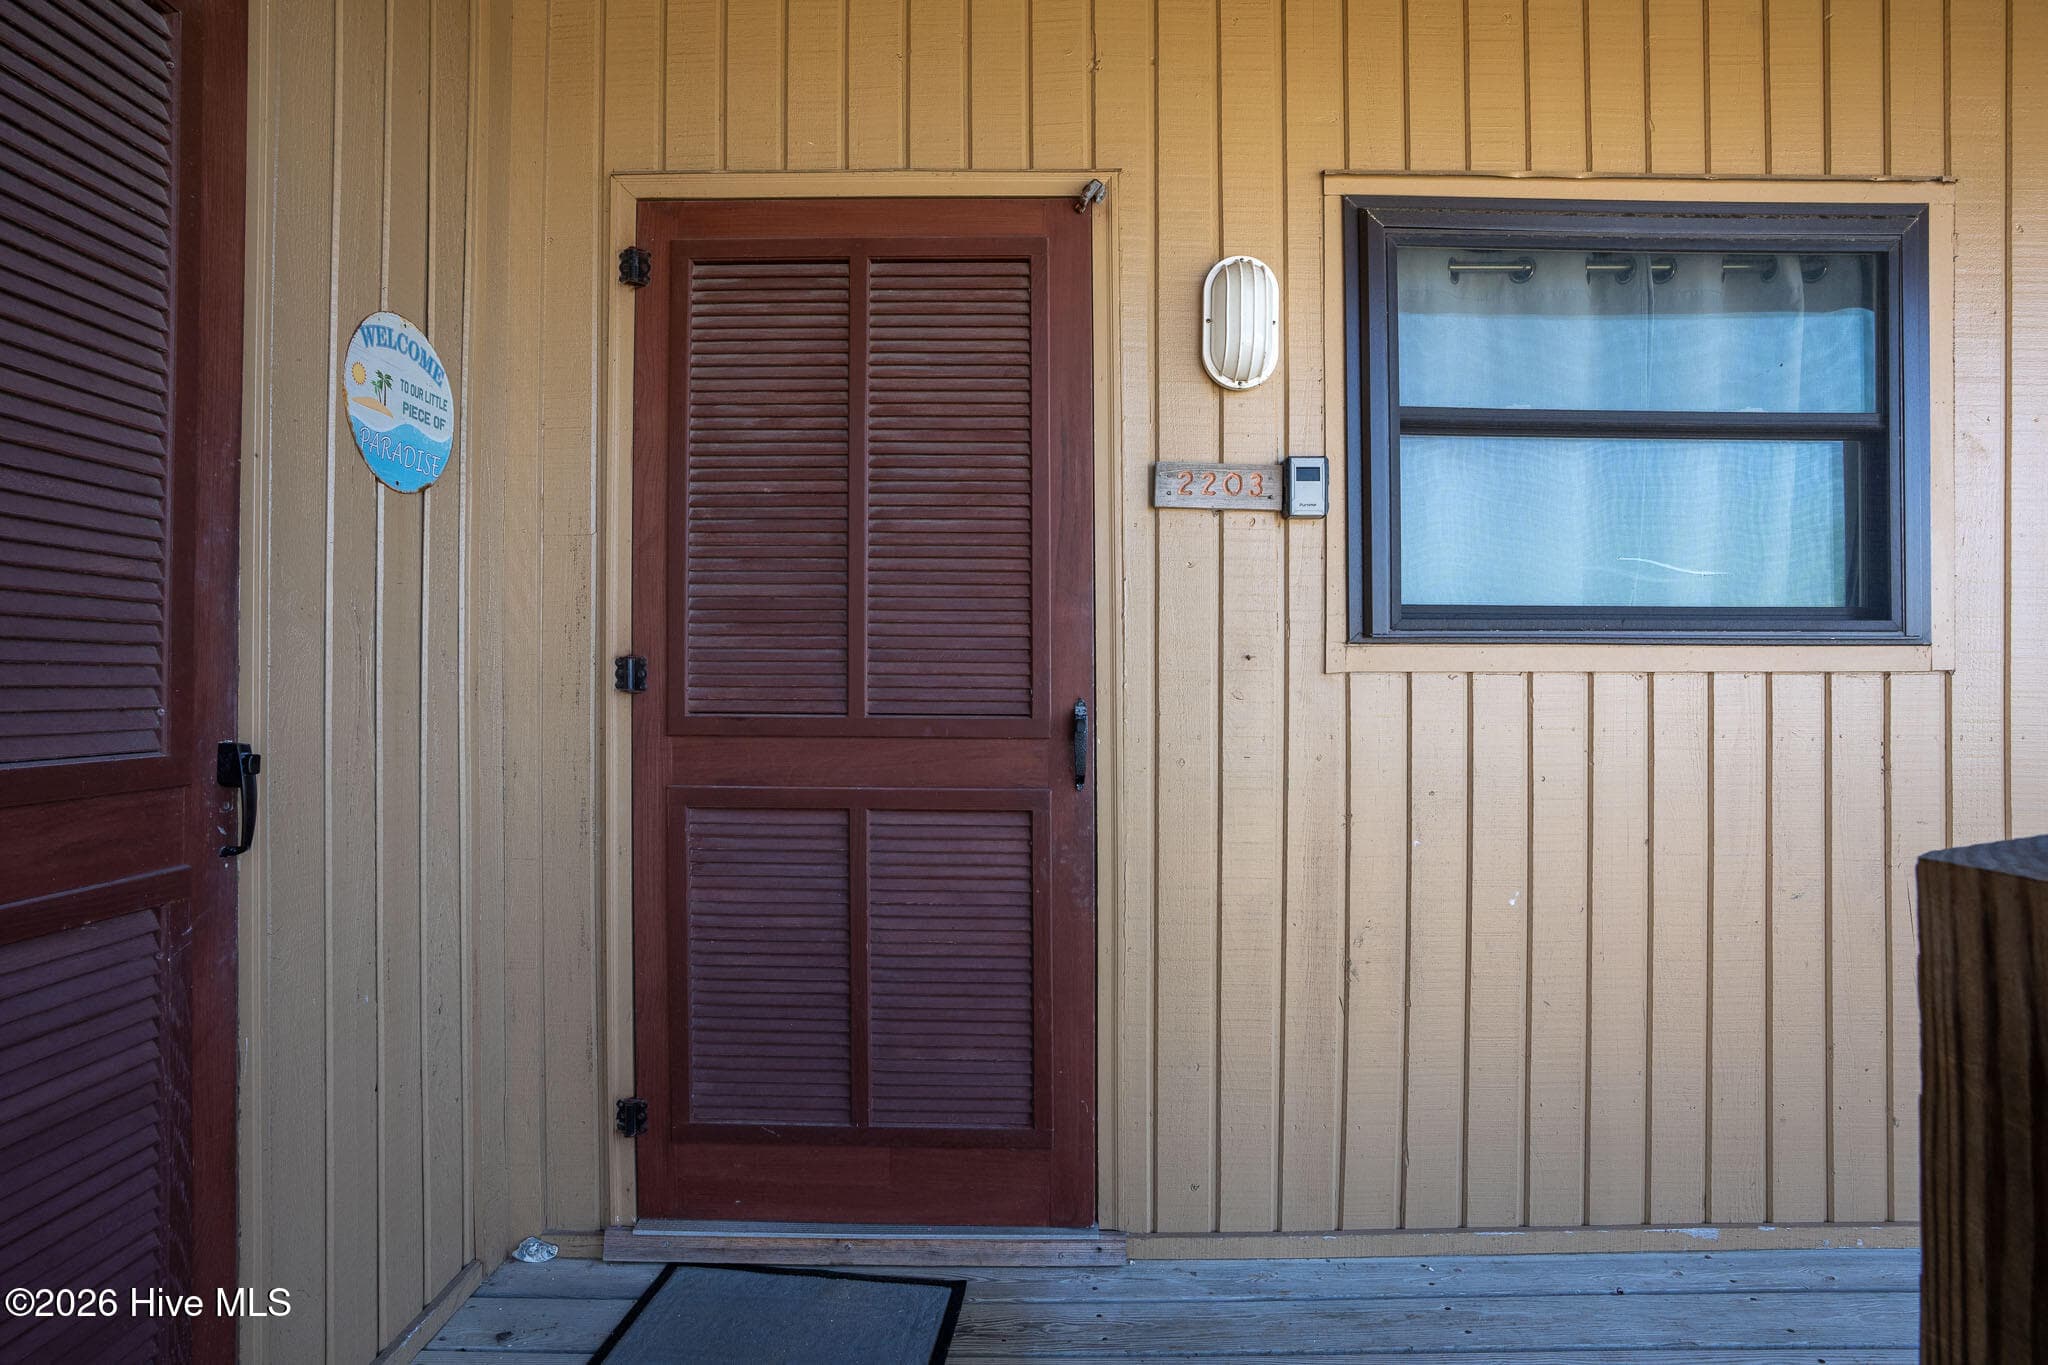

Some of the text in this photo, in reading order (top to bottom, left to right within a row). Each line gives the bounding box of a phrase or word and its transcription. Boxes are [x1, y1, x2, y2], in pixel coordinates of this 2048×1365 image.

[360, 324, 445, 388] WELCOME
[400, 378, 448, 412] TO OUR LITTLE
[402, 402, 446, 431] PIECE OF
[359, 426, 441, 478] PARADISE
[1177, 471, 1264, 497] 2203
